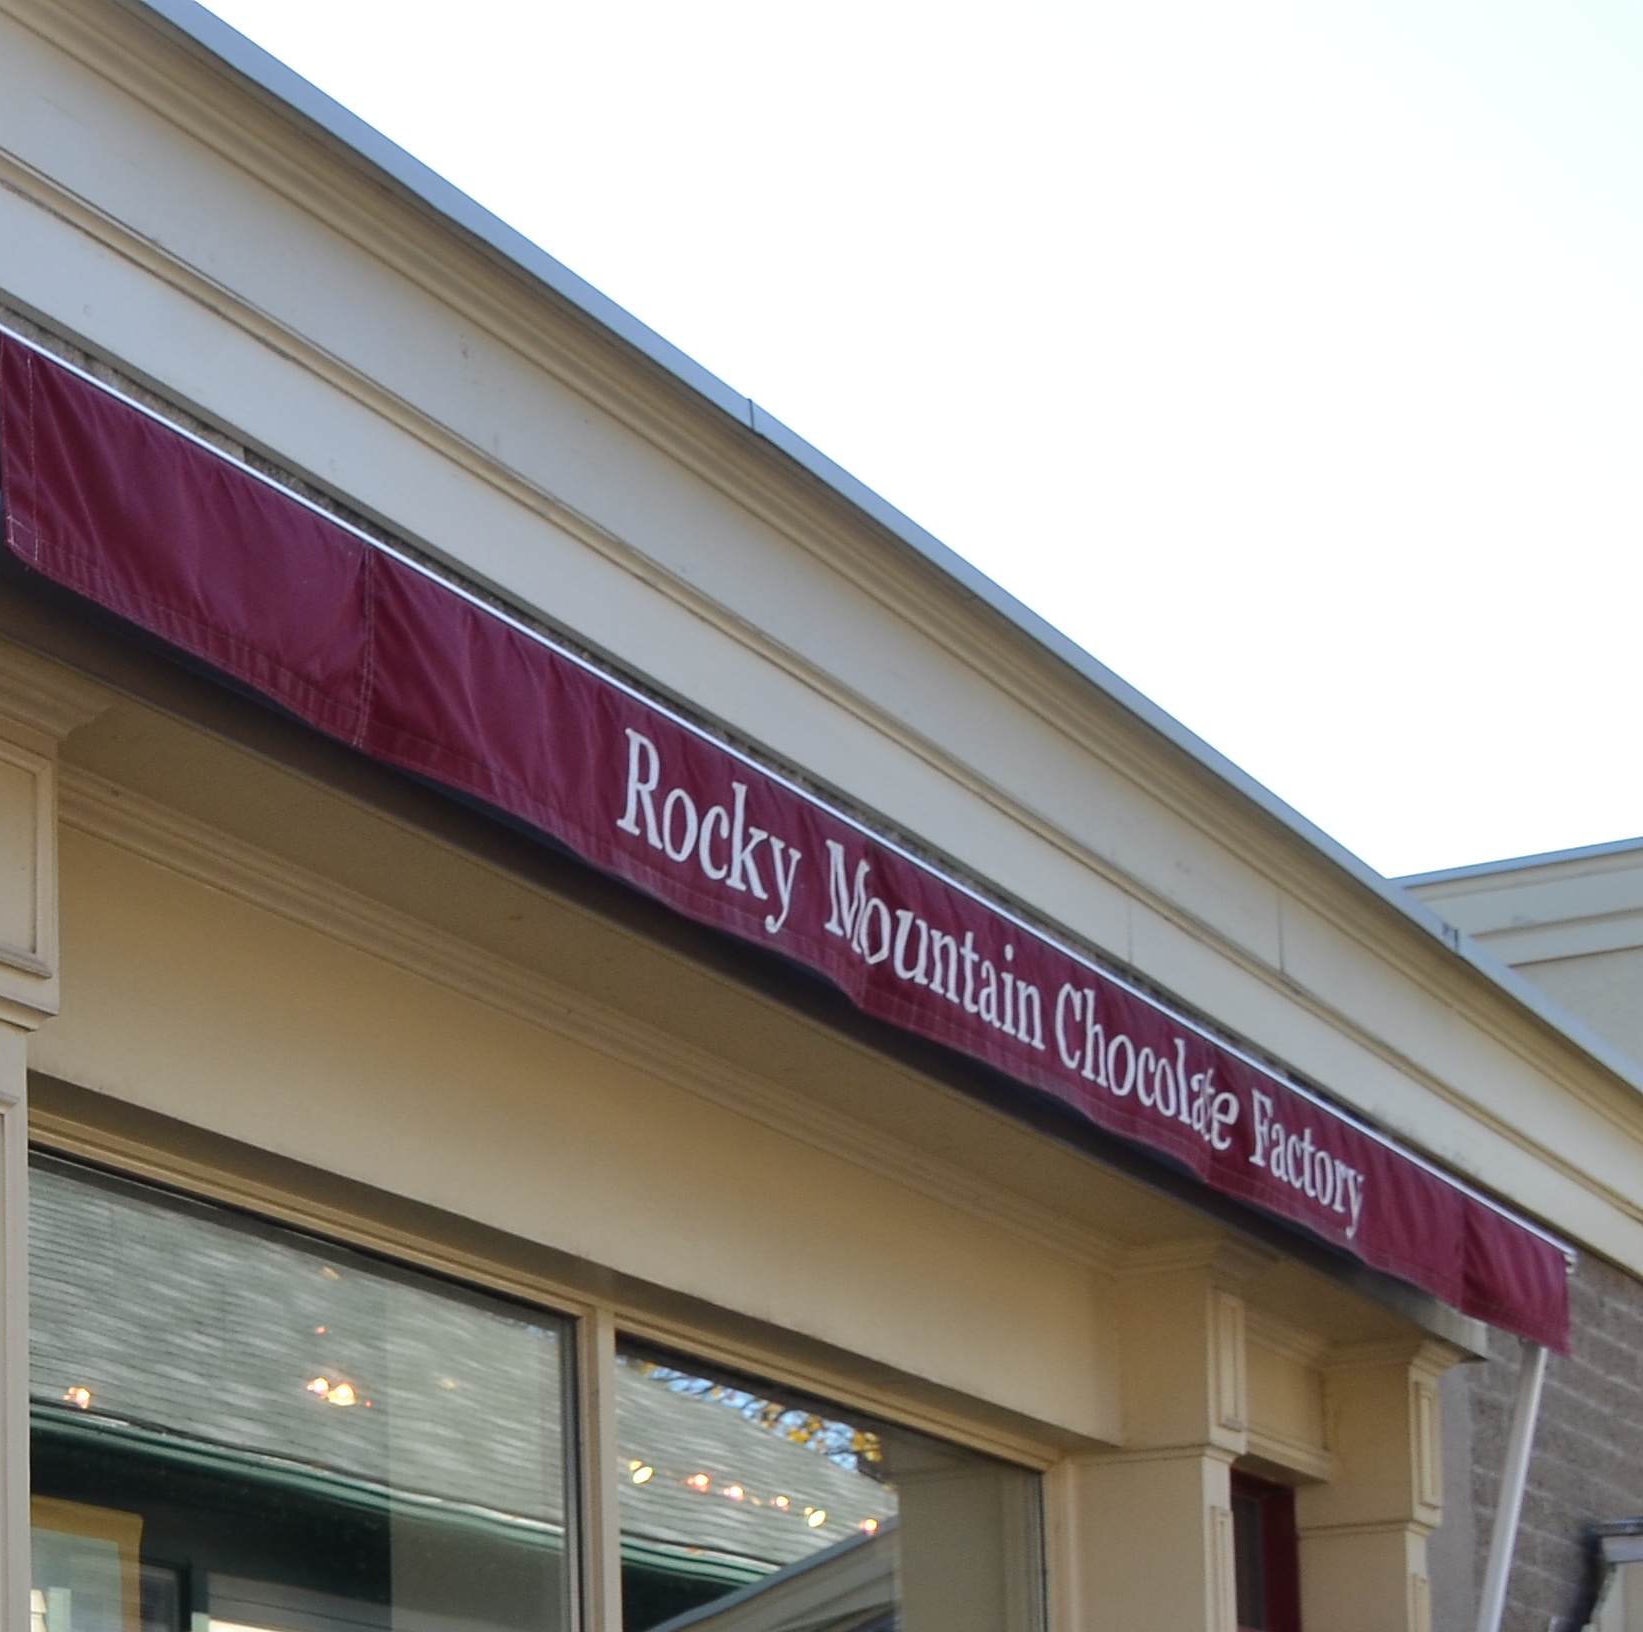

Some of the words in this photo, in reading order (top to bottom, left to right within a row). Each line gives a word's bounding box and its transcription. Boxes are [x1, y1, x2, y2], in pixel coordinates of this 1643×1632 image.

[617, 727, 802, 934] Rocky
[823, 838, 1046, 1051] Mountain
[1055, 983, 1240, 1151] Chocolate
[1248, 1088, 1365, 1240] Factory
